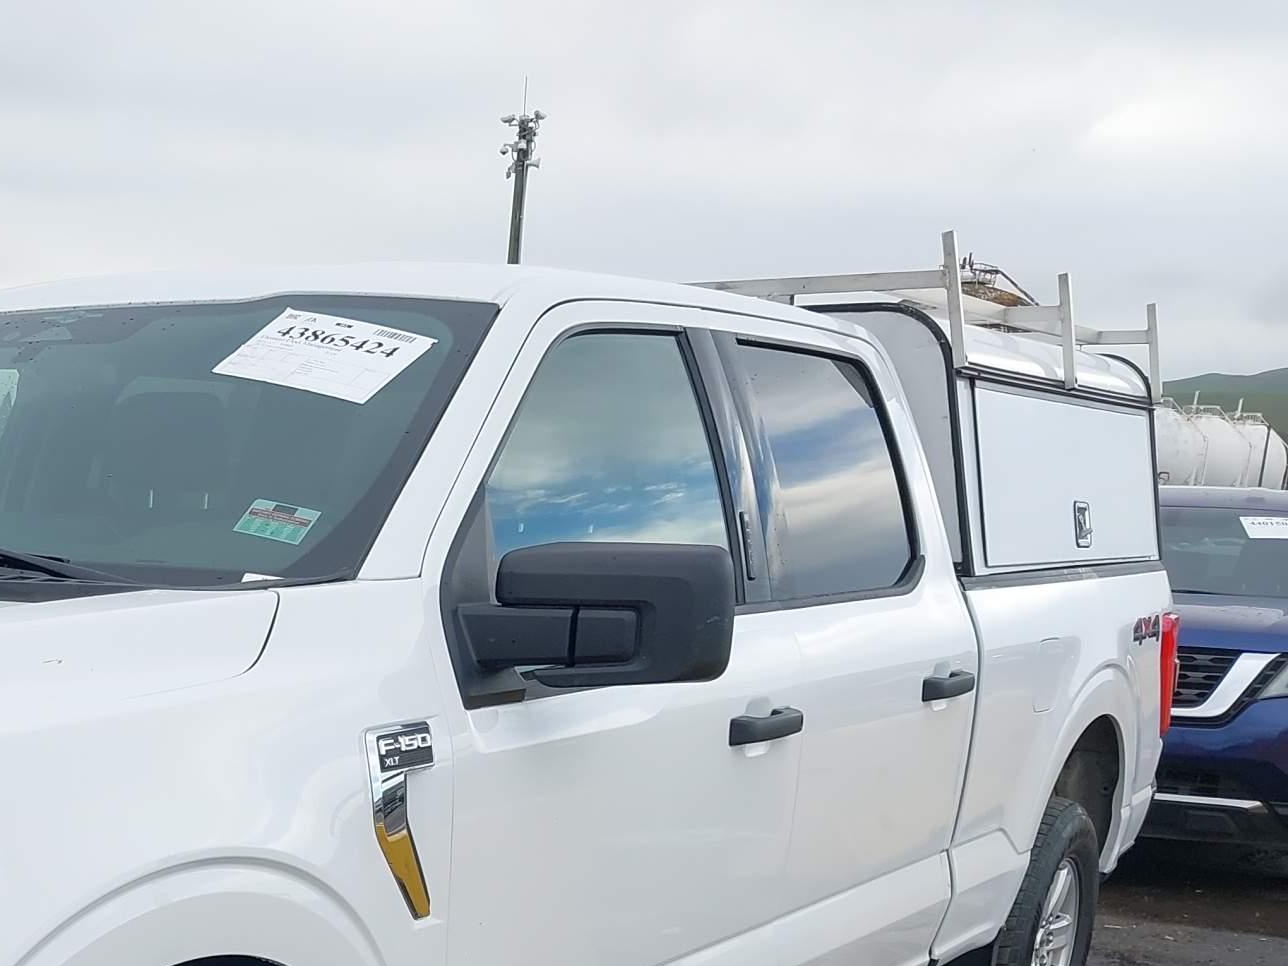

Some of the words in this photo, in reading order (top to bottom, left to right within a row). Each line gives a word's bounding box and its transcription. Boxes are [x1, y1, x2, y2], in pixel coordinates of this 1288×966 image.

[277, 325, 401, 358] 43865424
[378, 733, 431, 755] F-150
[384, 756, 400, 767] XLT
